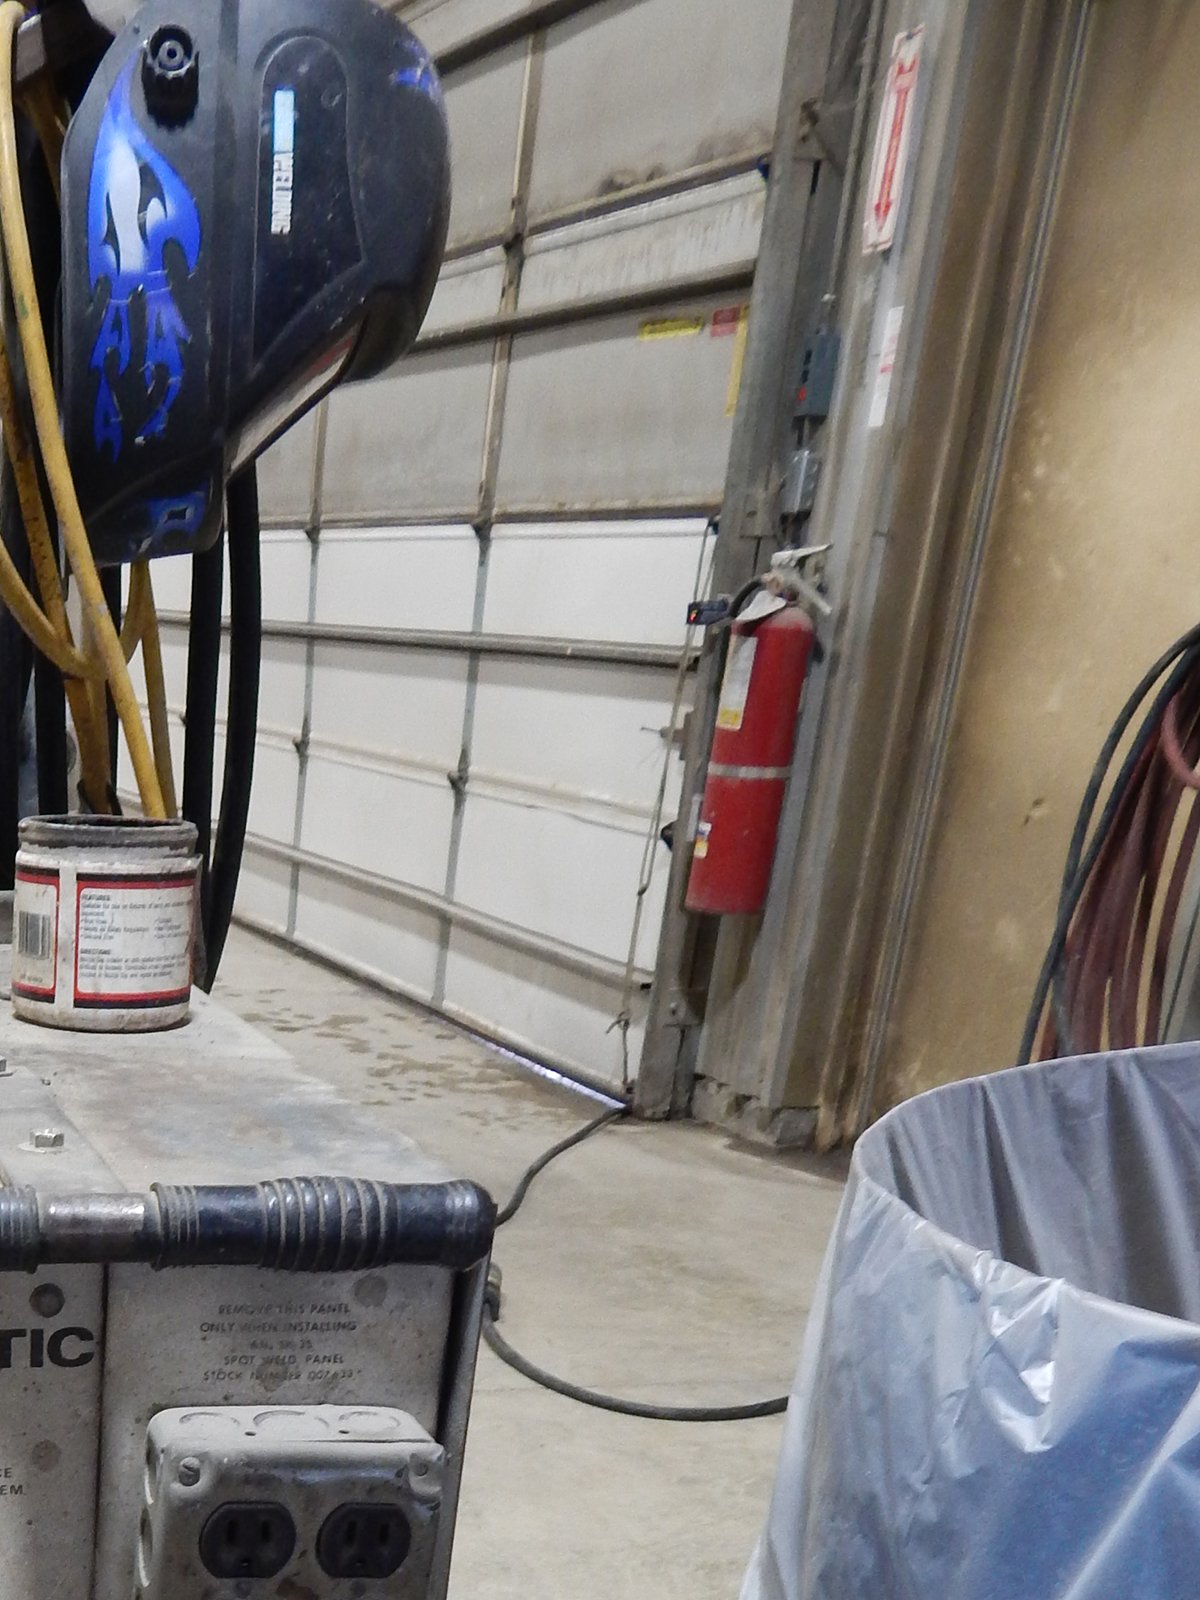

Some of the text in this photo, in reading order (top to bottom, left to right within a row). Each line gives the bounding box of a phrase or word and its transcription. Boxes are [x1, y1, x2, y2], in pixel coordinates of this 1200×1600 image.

[310, 1303, 351, 1314] PANEL
[200, 1322, 235, 1333] ONLY
[224, 1355, 256, 1366] SPOT
[306, 1353, 345, 1364] PANEL
[202, 1371, 243, 1382] STOCK
